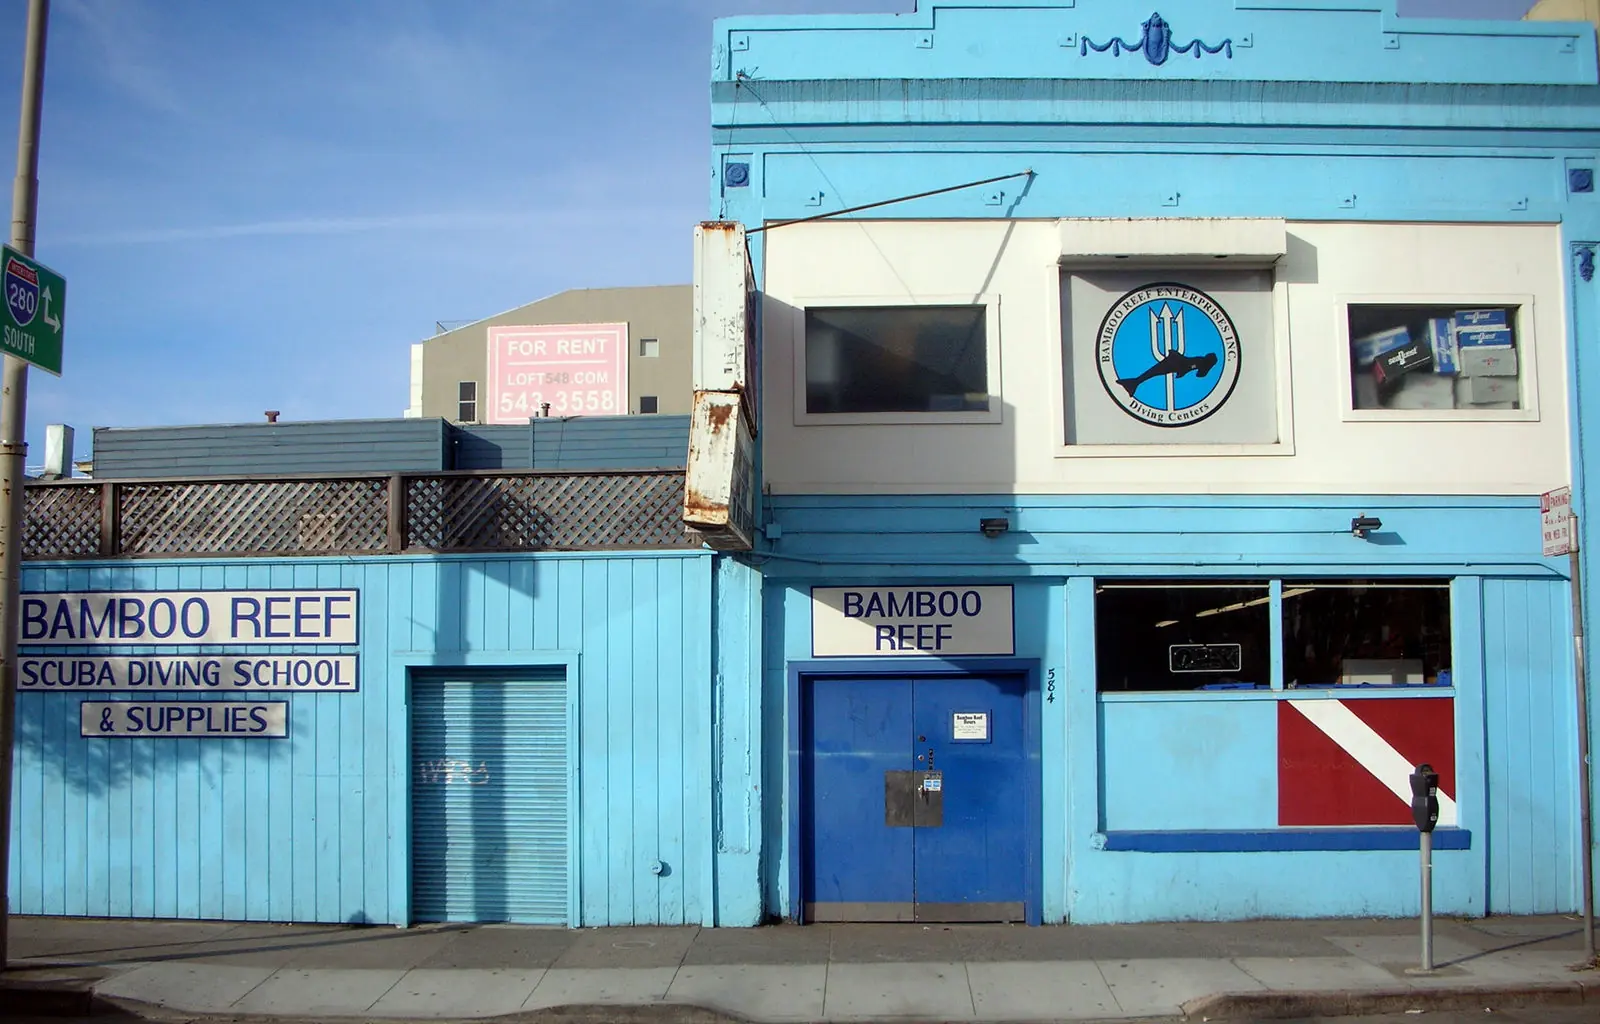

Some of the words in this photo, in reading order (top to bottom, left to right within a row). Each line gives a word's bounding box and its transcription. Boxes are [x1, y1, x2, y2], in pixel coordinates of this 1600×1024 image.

[10, 283, 35, 314] 280
[1101, 310, 1123, 363] BAMBOO
[1124, 289, 1152, 311] REEF
[1156, 288, 1229, 333] ENTERPRISES
[1225, 335, 1237, 362] INC.
[4, 325, 36, 357] SOUTH
[507, 341, 546, 356] FOR
[557, 338, 608, 354] RENT
[507, 372, 608, 386] LOFT548.COM
[1129, 400, 1164, 422] Diving
[1168, 403, 1209, 421] Centers
[22, 597, 210, 639] BAMBOO
[231, 596, 351, 639] REEF
[843, 590, 982, 618] BAMBOO
[875, 624, 953, 651] REEF
[21, 660, 117, 686] SCUBA
[128, 660, 220, 686] DIVING
[233, 660, 350, 686] SCHOOL
[1046, 668, 1056, 704] 584
[99, 707, 115, 732] &
[126, 706, 268, 732] SUPPLIES
